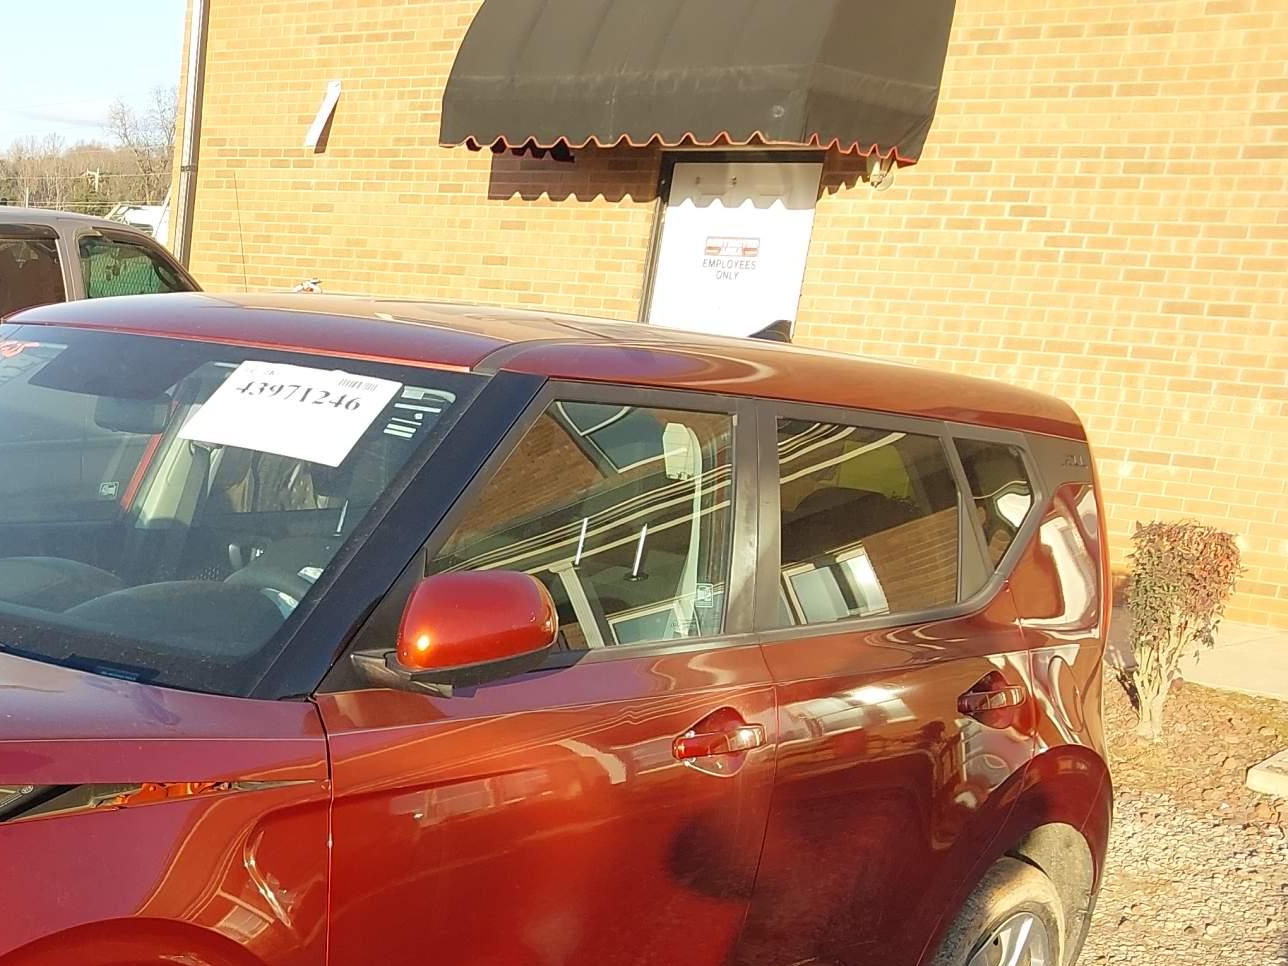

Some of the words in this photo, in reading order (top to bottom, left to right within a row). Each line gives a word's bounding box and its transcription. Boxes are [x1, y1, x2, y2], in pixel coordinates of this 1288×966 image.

[702, 259, 757, 270] EMPLOYEES
[715, 270, 739, 280] ONLY
[235, 380, 362, 413] 43971246
